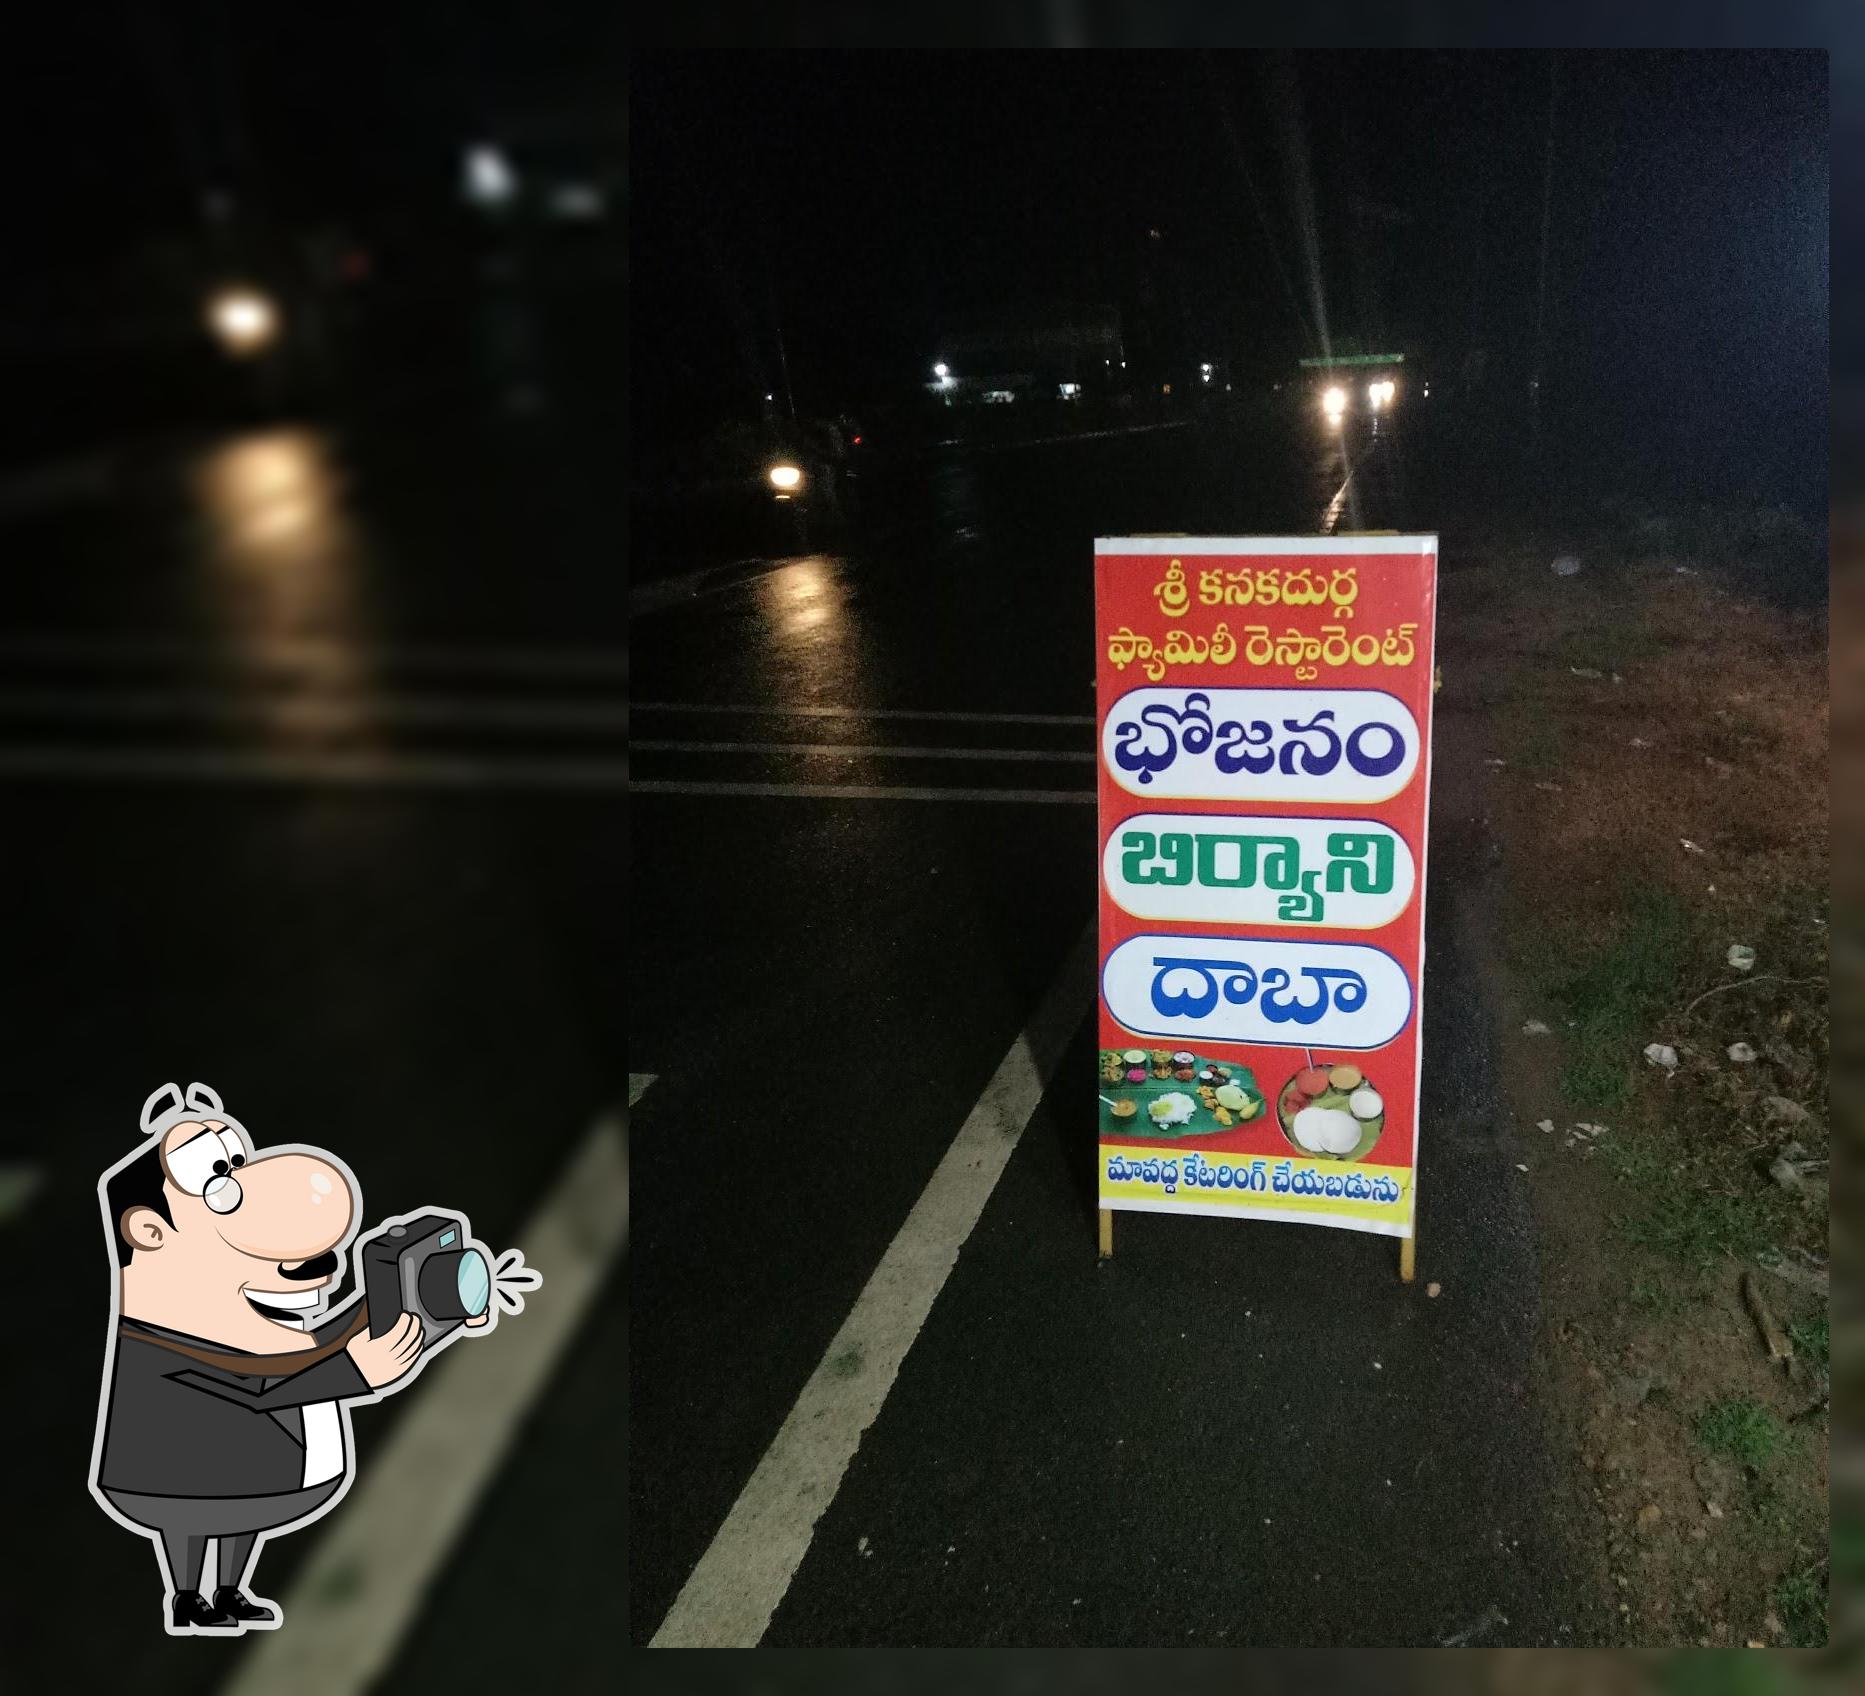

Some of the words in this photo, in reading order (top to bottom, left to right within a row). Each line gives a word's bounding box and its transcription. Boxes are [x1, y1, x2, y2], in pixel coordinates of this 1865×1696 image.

[1154, 560, 1190, 616] శ్రీ
[1199, 568, 1358, 618] కనకదుర్గ
[1108, 623, 1237, 681] ఫ్యామిలీ
[1245, 623, 1418, 680] రెస్టారెంట్
[1115, 693, 1406, 784] భోజనం
[1122, 832, 1394, 921] బిర్యాని
[1151, 957, 1367, 1024] దాబా
[1108, 1156, 1178, 1193] మావద్ద
[1183, 1153, 1266, 1191] కేటరింగ్
[1272, 1161, 1399, 1202] చేయబడును
